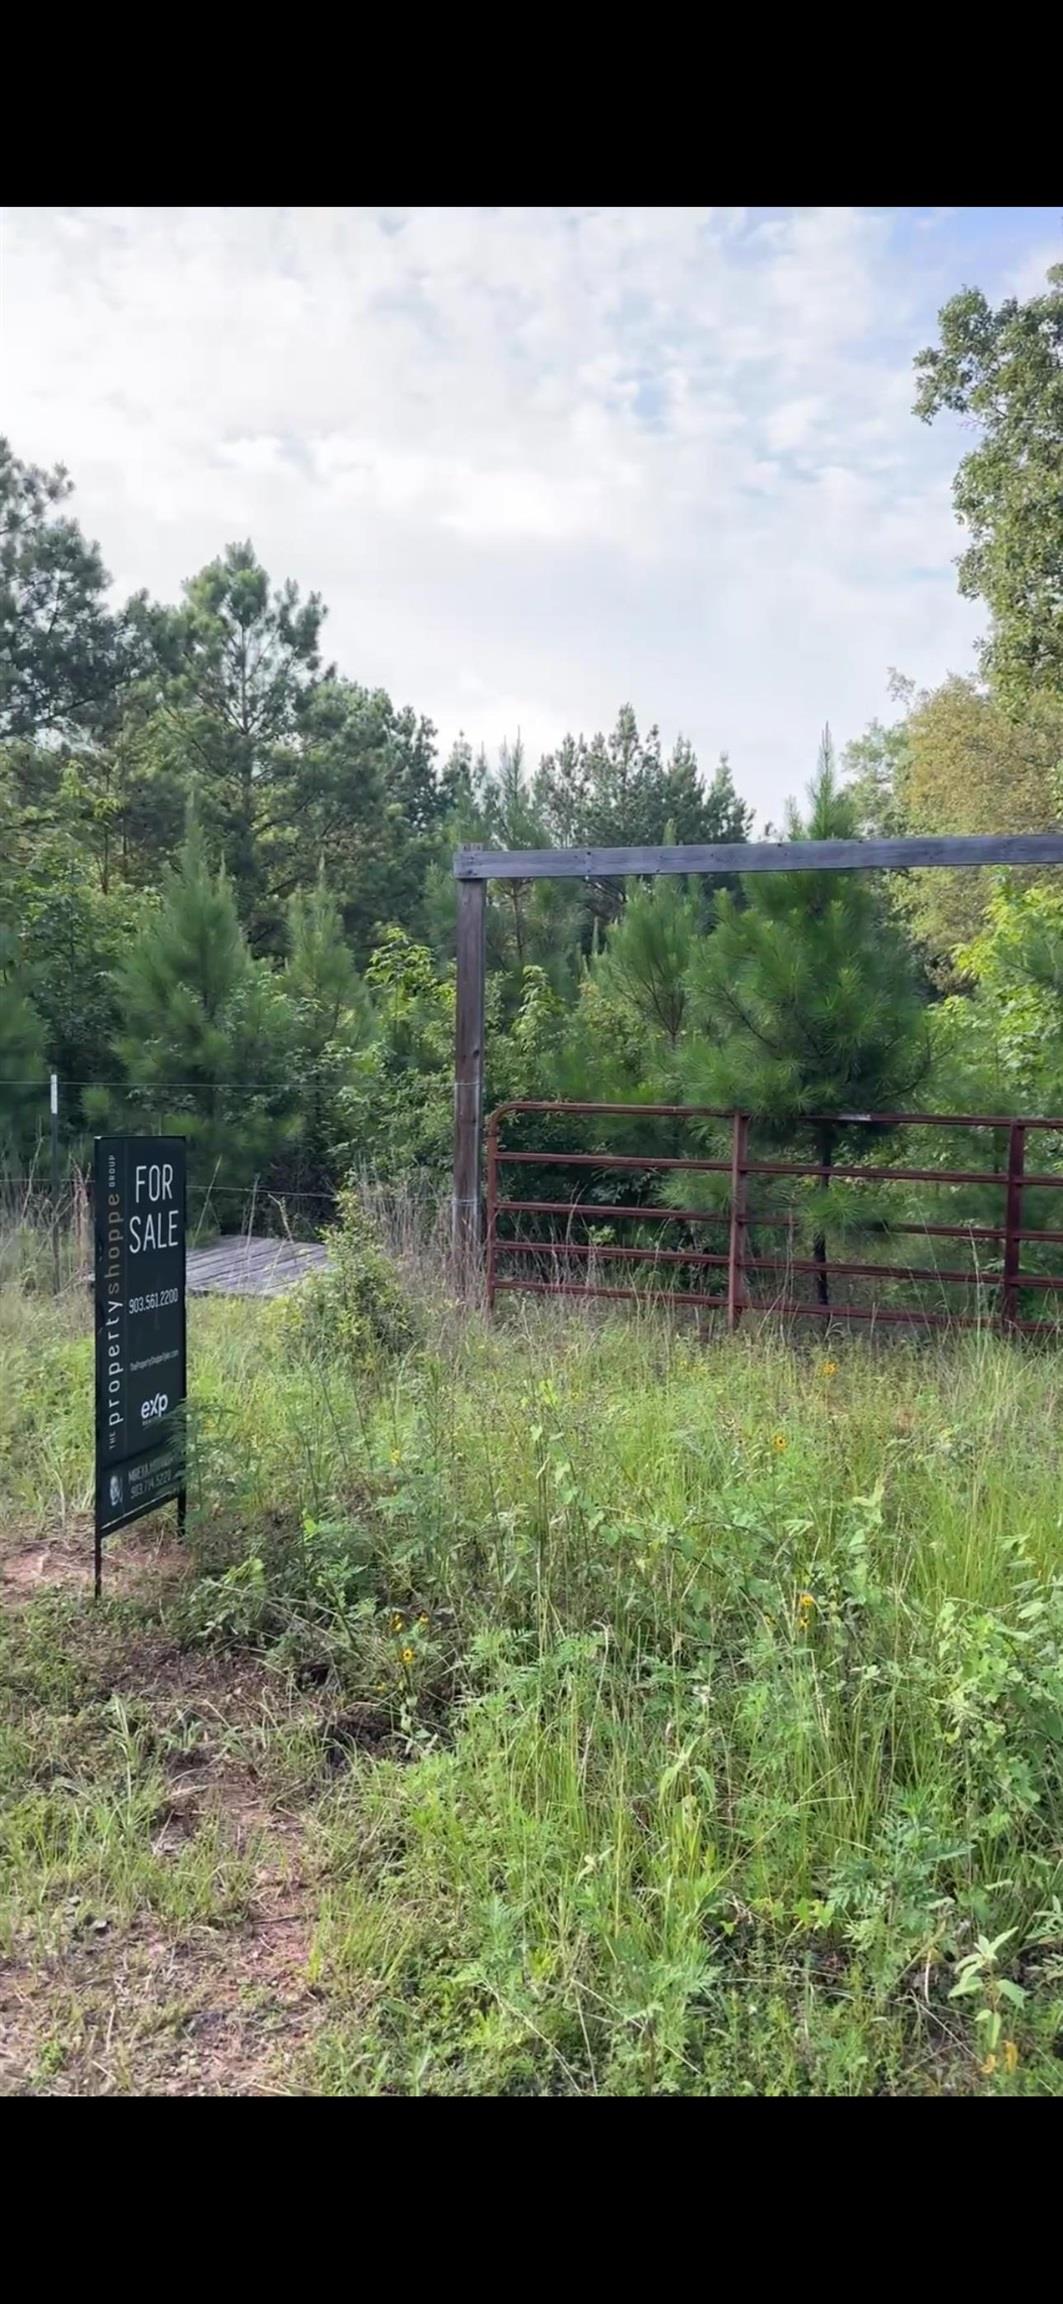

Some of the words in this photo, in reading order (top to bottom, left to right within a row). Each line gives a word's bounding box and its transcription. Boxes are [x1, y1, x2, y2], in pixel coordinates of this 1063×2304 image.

[108, 1155, 116, 1188] GROUP
[136, 1163, 173, 1203] FOR
[129, 1210, 179, 1254] SALE
[129, 1288, 179, 1314] 903.561.2200
